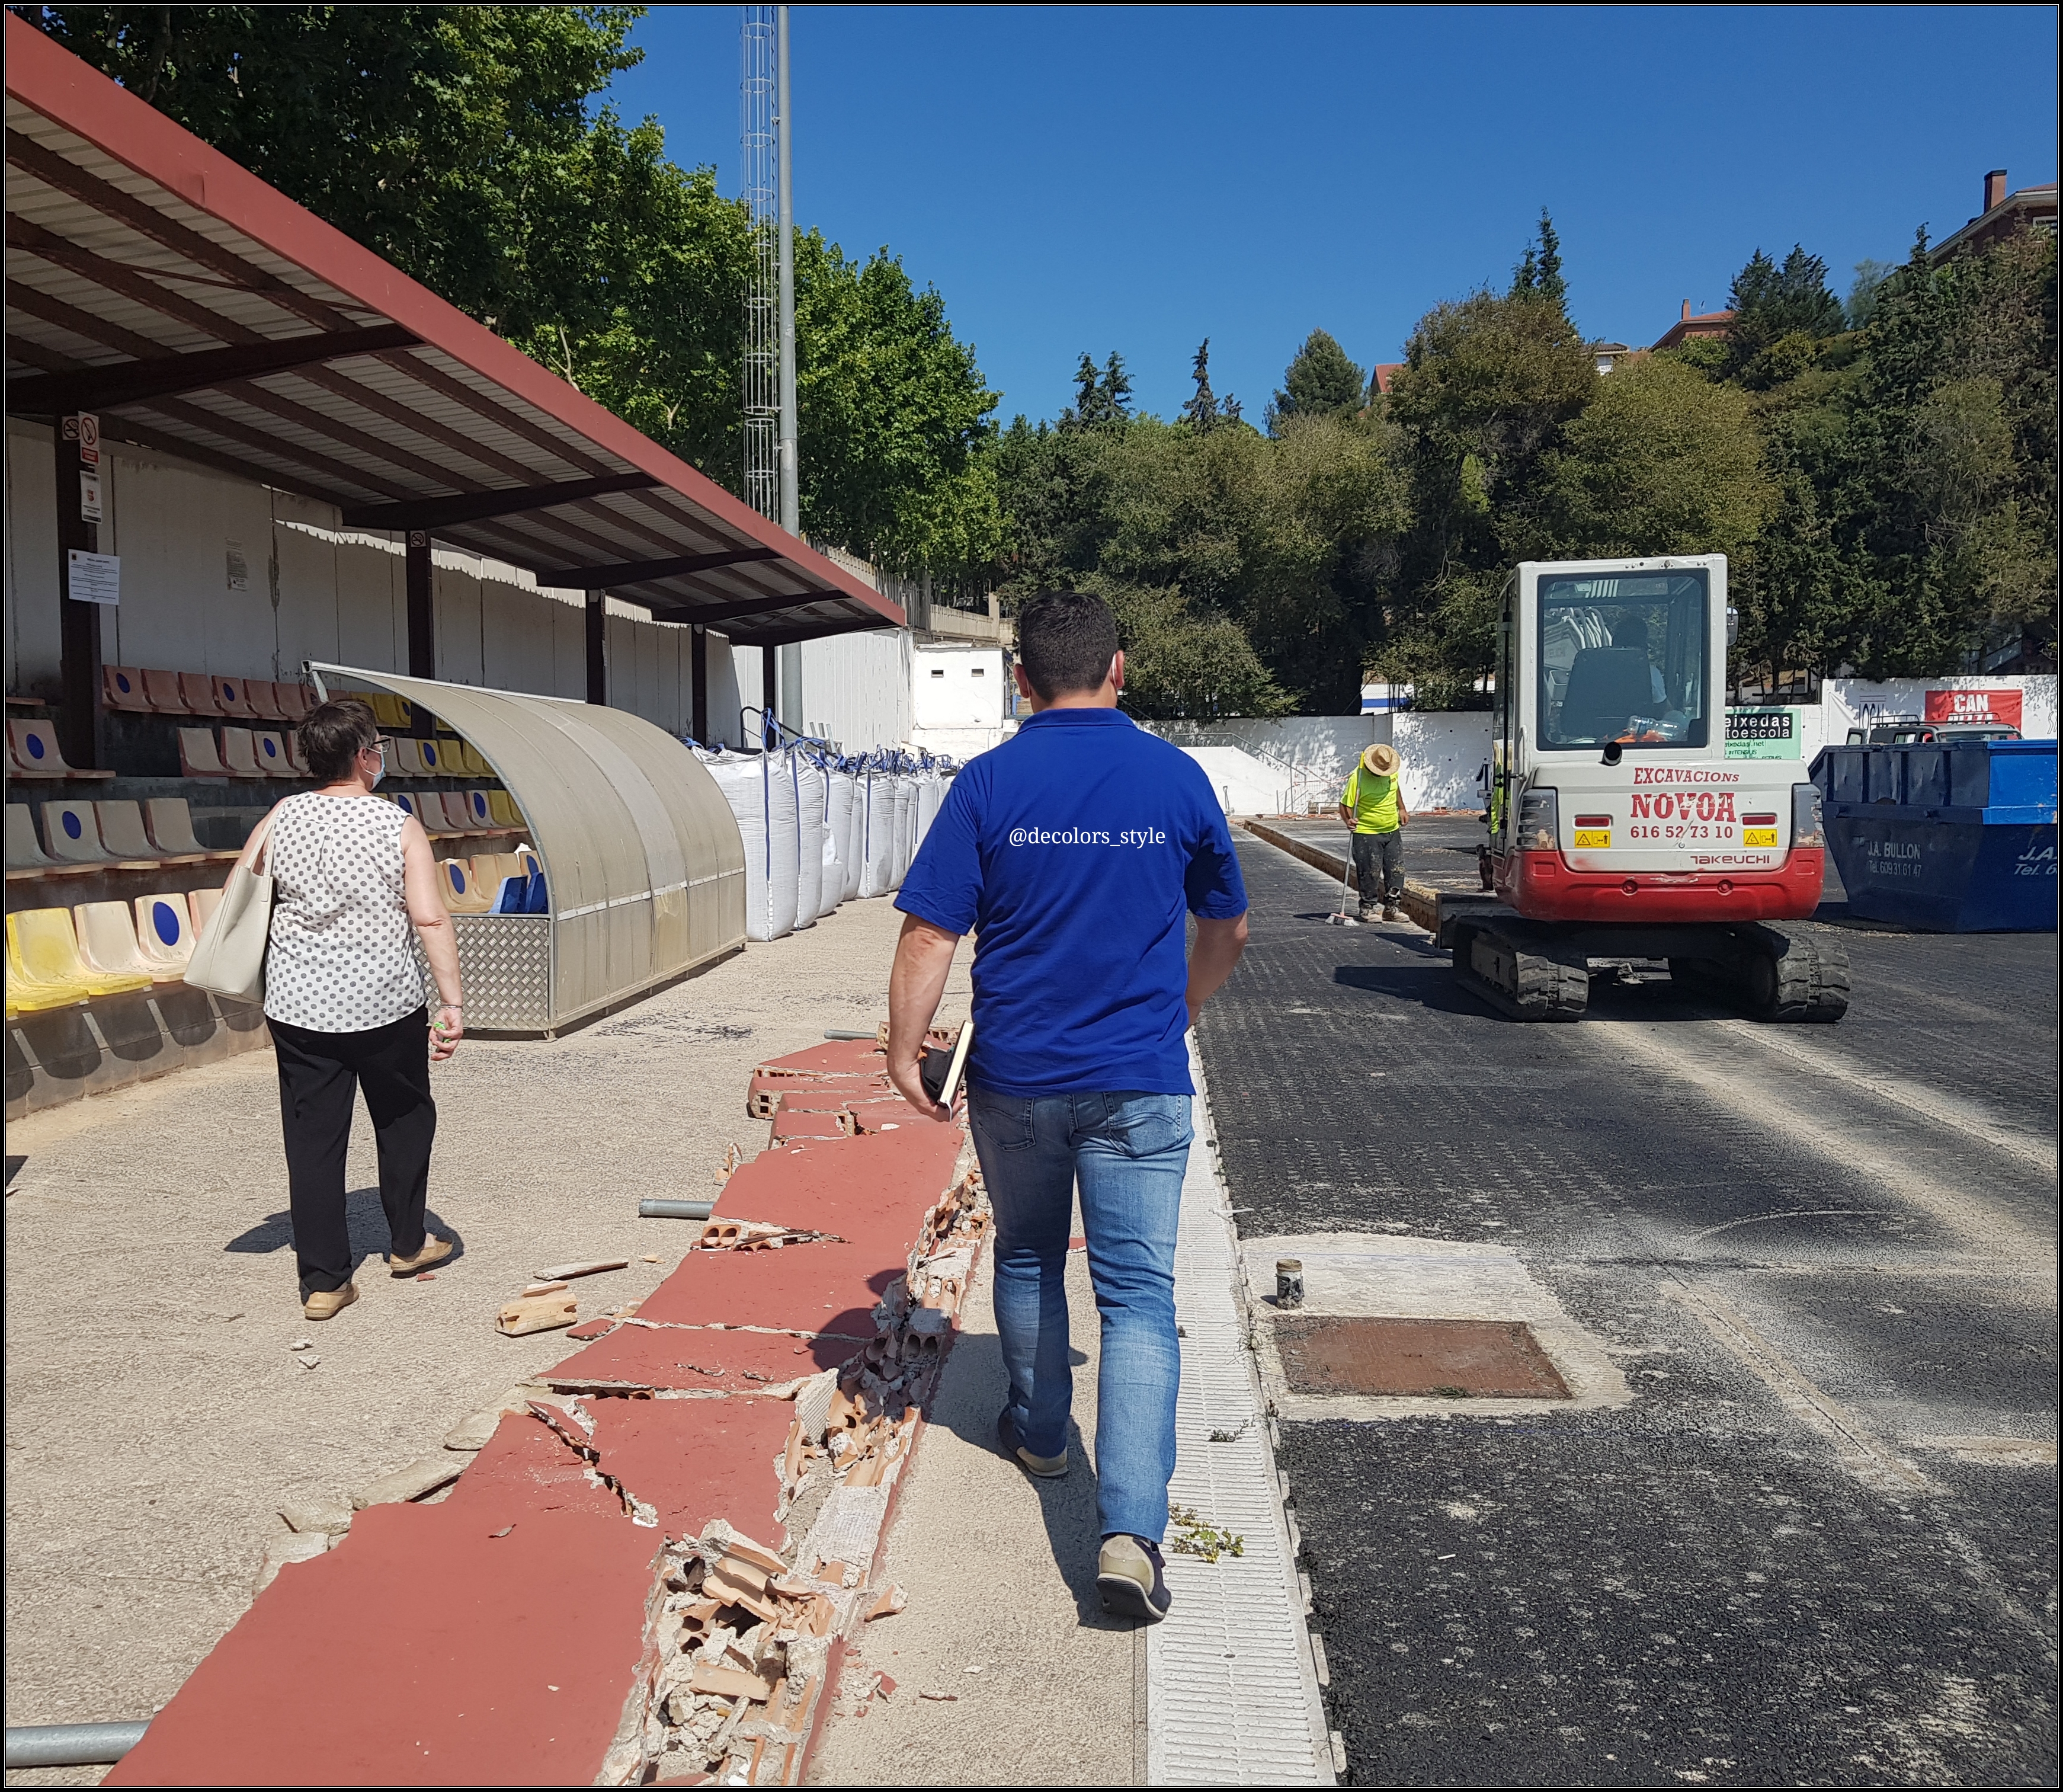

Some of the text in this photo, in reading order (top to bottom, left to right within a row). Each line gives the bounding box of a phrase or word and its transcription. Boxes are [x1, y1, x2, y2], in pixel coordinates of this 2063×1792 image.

[1953, 694, 1988, 712] CAN
[1726, 726, 1790, 738] toescola
[1633, 767, 1740, 785] EXCAVACIONS
[1630, 792, 1737, 823] NOVOA
[1630, 825, 1733, 839] 616 52 73 10
[2014, 863, 2040, 875] Tel.
